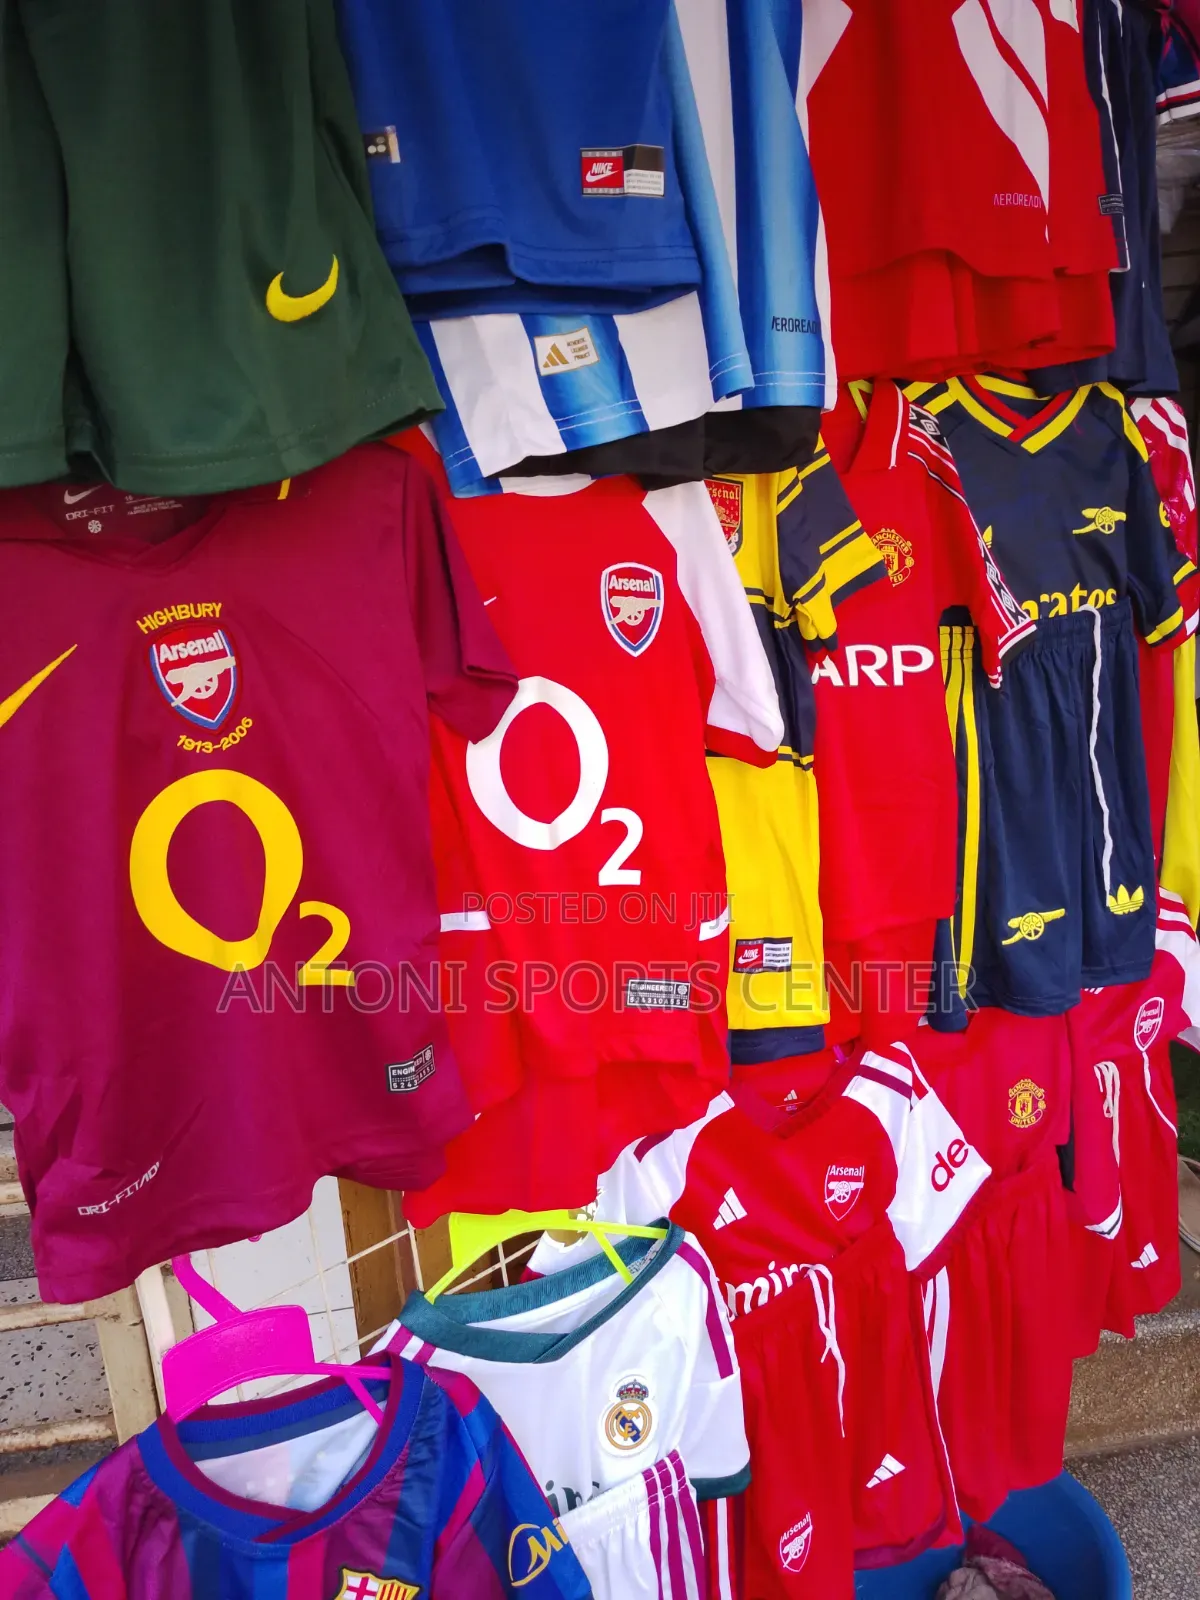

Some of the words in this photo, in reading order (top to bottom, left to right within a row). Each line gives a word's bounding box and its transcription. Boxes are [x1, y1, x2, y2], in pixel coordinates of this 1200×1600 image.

[591, 163, 614, 174] NIKE
[65, 505, 115, 520] DRI-FIT
[609, 575, 655, 592] Arsenal
[136, 602, 222, 634] HIGHBURY
[160, 632, 224, 663] Arsenal
[177, 717, 253, 753] 1913-2006
[743, 948, 759, 958] NIKE
[630, 983, 674, 993] ENGINEERED
[829, 1164, 863, 1177] Arsenal
[727, 1261, 799, 1323] mir
[781, 1512, 810, 1542] Arsenal
